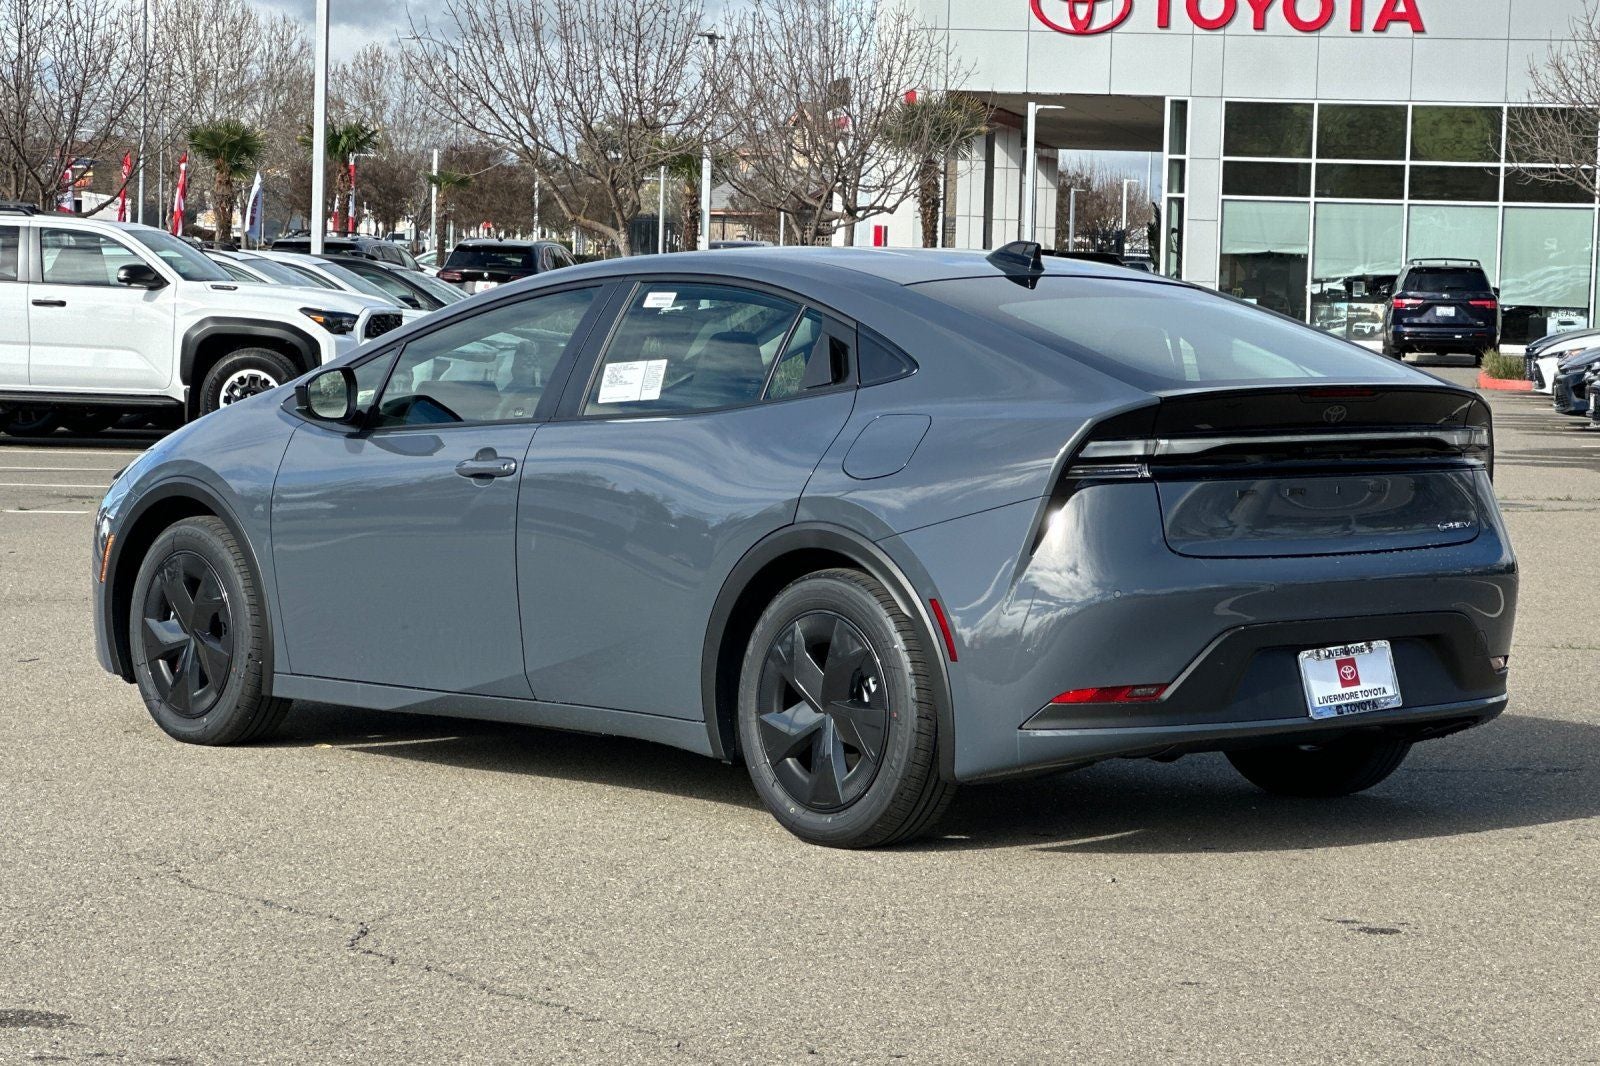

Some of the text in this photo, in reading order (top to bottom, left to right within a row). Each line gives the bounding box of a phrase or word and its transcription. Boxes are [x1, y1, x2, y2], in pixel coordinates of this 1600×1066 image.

[1318, 687, 1387, 704] LIVERMORE TOYOTA
[1345, 700, 1378, 714] TOYOTA
